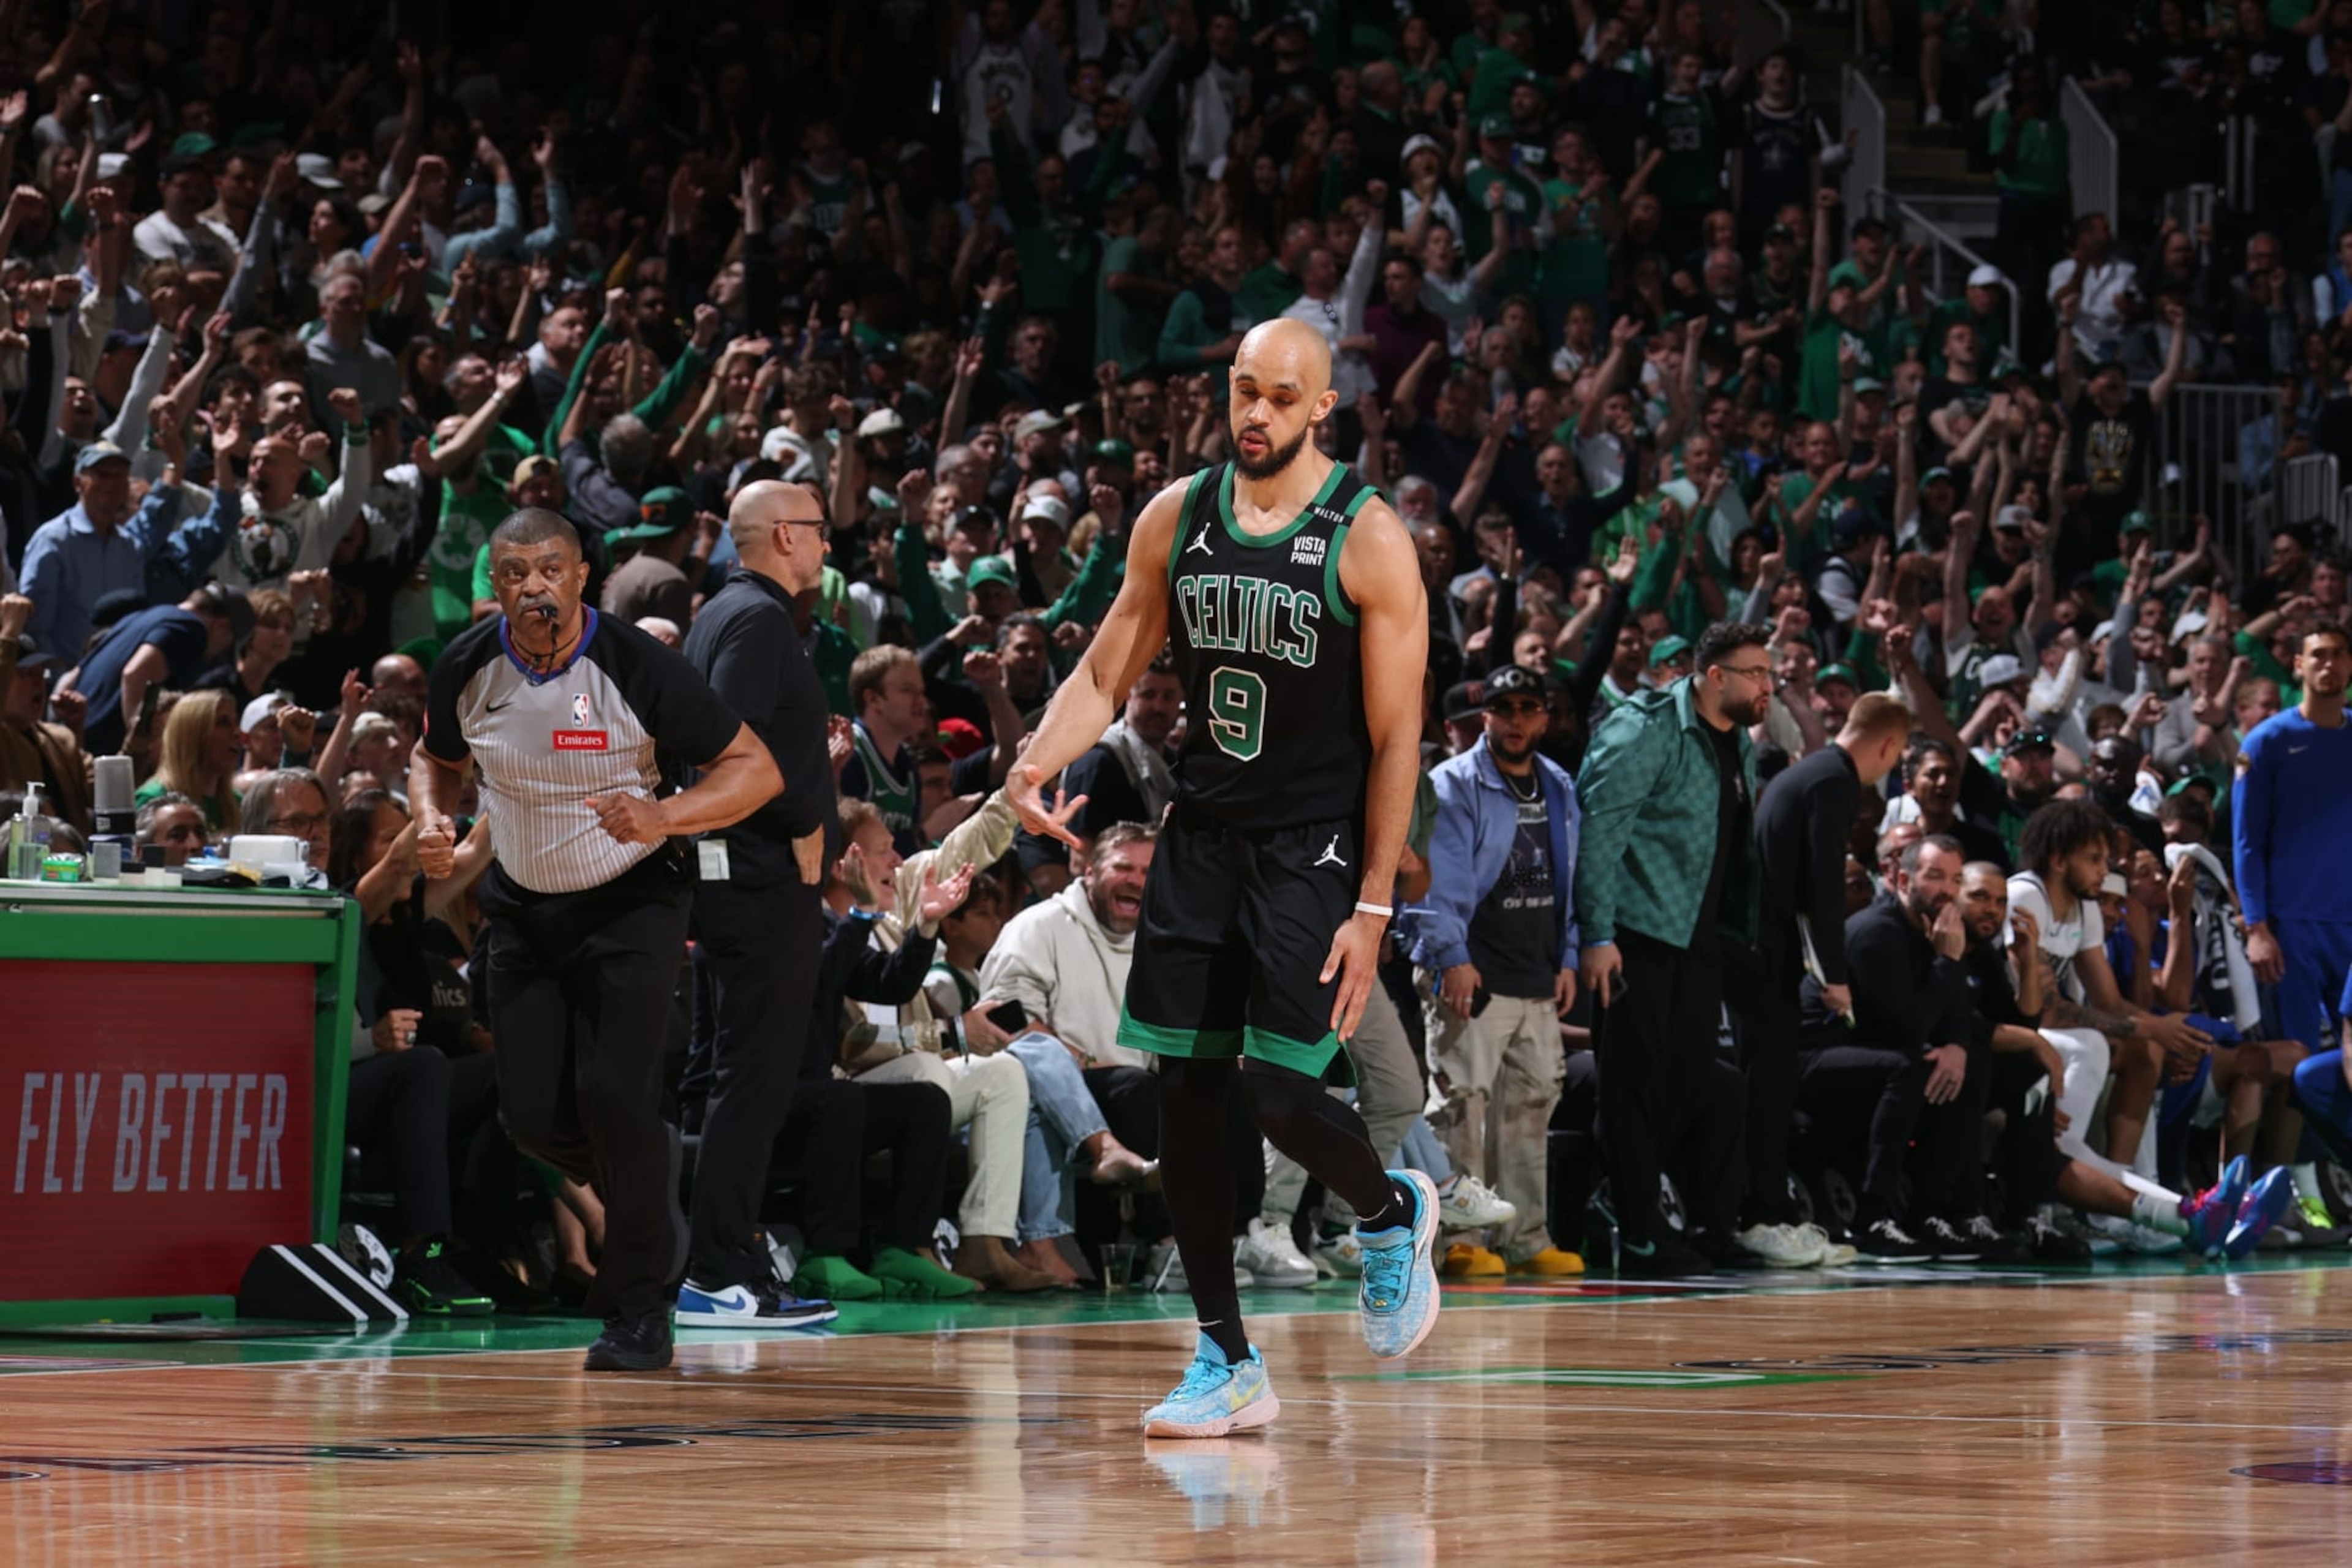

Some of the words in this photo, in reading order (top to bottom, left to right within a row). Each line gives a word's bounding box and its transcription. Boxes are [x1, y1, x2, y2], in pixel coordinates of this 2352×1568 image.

[1314, 506, 1345, 524] WALTON
[1294, 535, 1326, 554] VISTA
[1290, 551, 1324, 567] PRINT
[1176, 573, 1322, 669] CELTICS
[1208, 665, 1267, 762] 9
[557, 734, 603, 746] Emirates
[14, 1071, 102, 1194] FLY
[112, 1073, 288, 1193] BETTER
